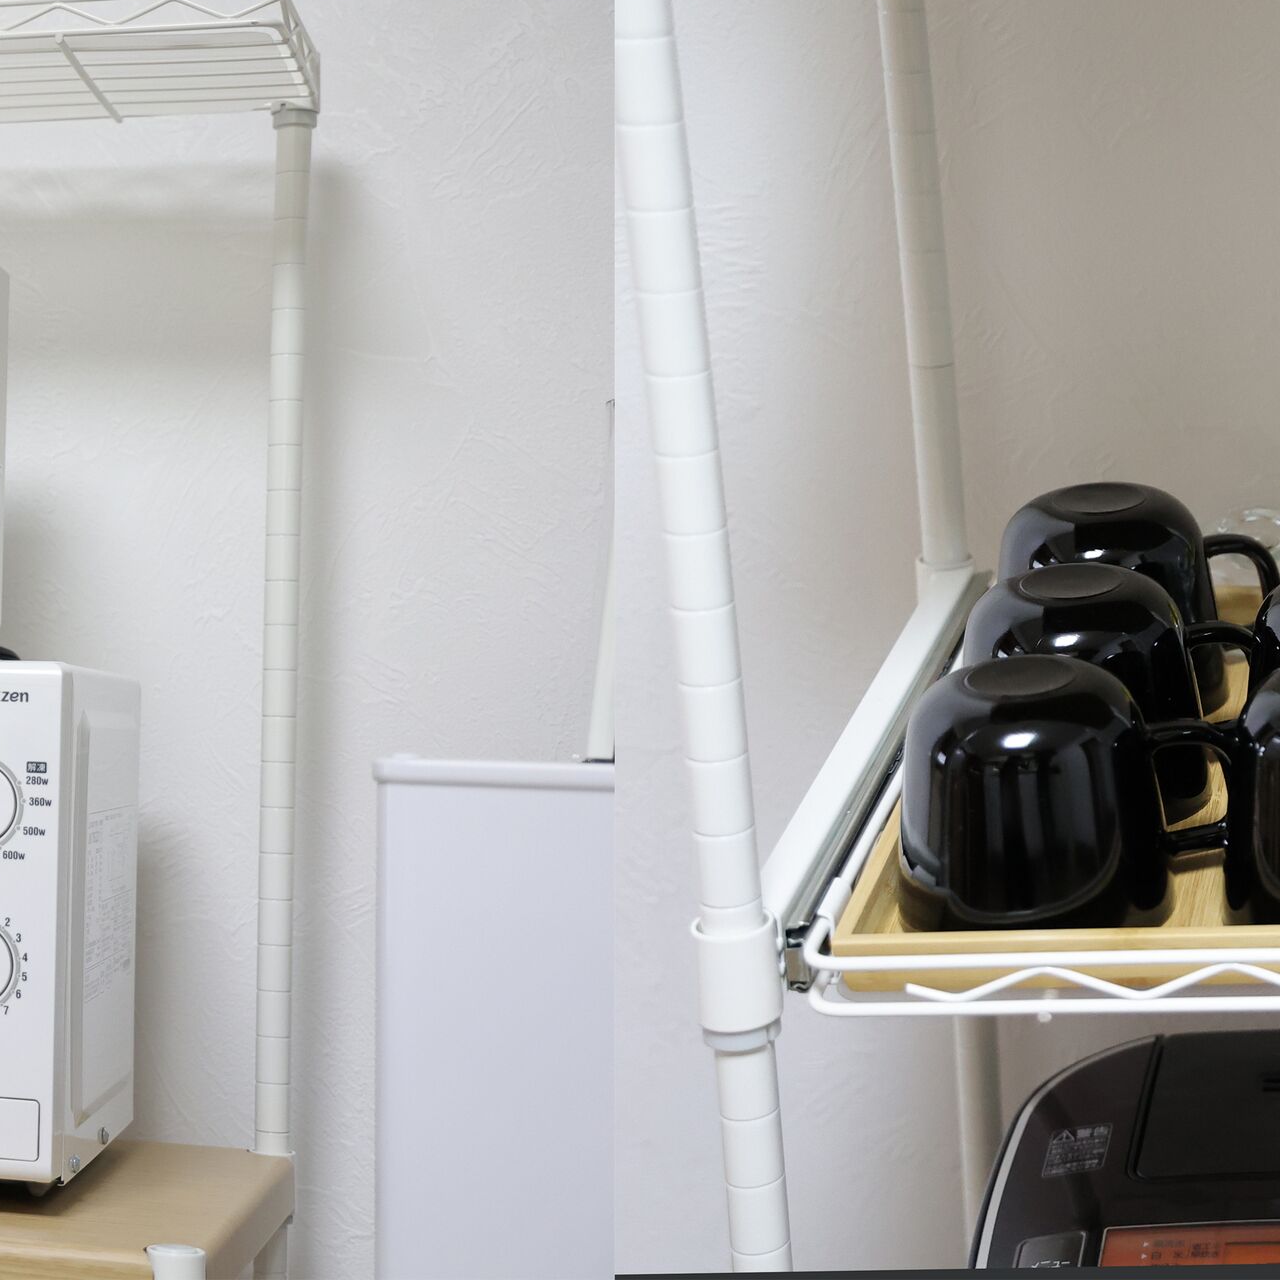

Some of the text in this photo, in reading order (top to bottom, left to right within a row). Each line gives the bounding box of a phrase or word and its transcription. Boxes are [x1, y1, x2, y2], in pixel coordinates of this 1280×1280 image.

[25, 775, 49, 786] 280w
[28, 797, 52, 808] 360w
[22, 826, 47, 837] 500w
[2, 850, 26, 861] 600w
[4, 917, 11, 927] 2
[15, 933, 22, 943] 3
[21, 952, 29, 963] 4
[21, 972, 28, 982] 5
[15, 989, 22, 1000] 6
[3, 1005, 10, 1016] 7
